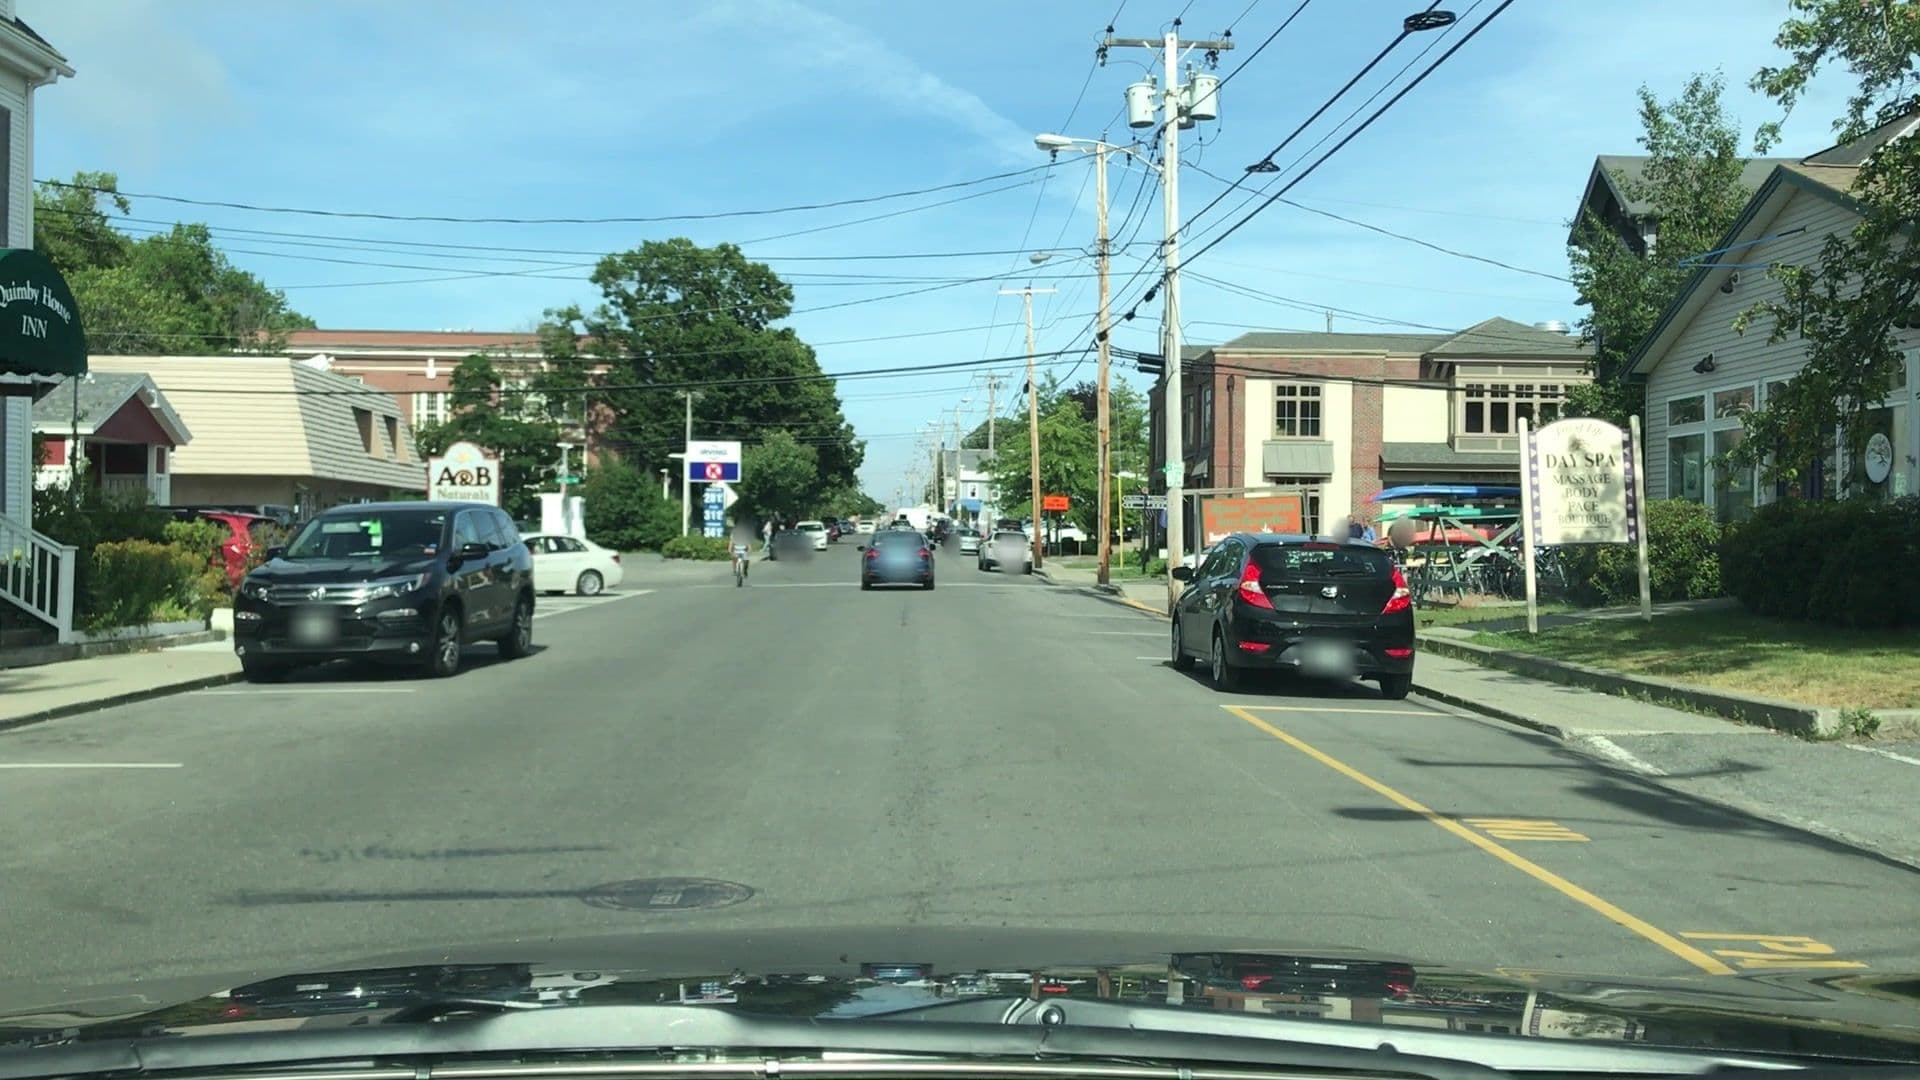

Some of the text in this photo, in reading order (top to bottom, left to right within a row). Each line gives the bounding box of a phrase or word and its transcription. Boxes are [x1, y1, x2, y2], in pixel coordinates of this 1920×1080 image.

[43, 285, 71, 324] House
[22, 314, 48, 338] INN
[1545, 453, 1616, 468] DAY SPA
[1553, 473, 1611, 485] MASSAGE
[437, 488, 489, 500] Naturals
[1566, 487, 1599, 498] BODY
[1568, 501, 1599, 512] FACE
[1559, 515, 1612, 526] BOUTIQUE
